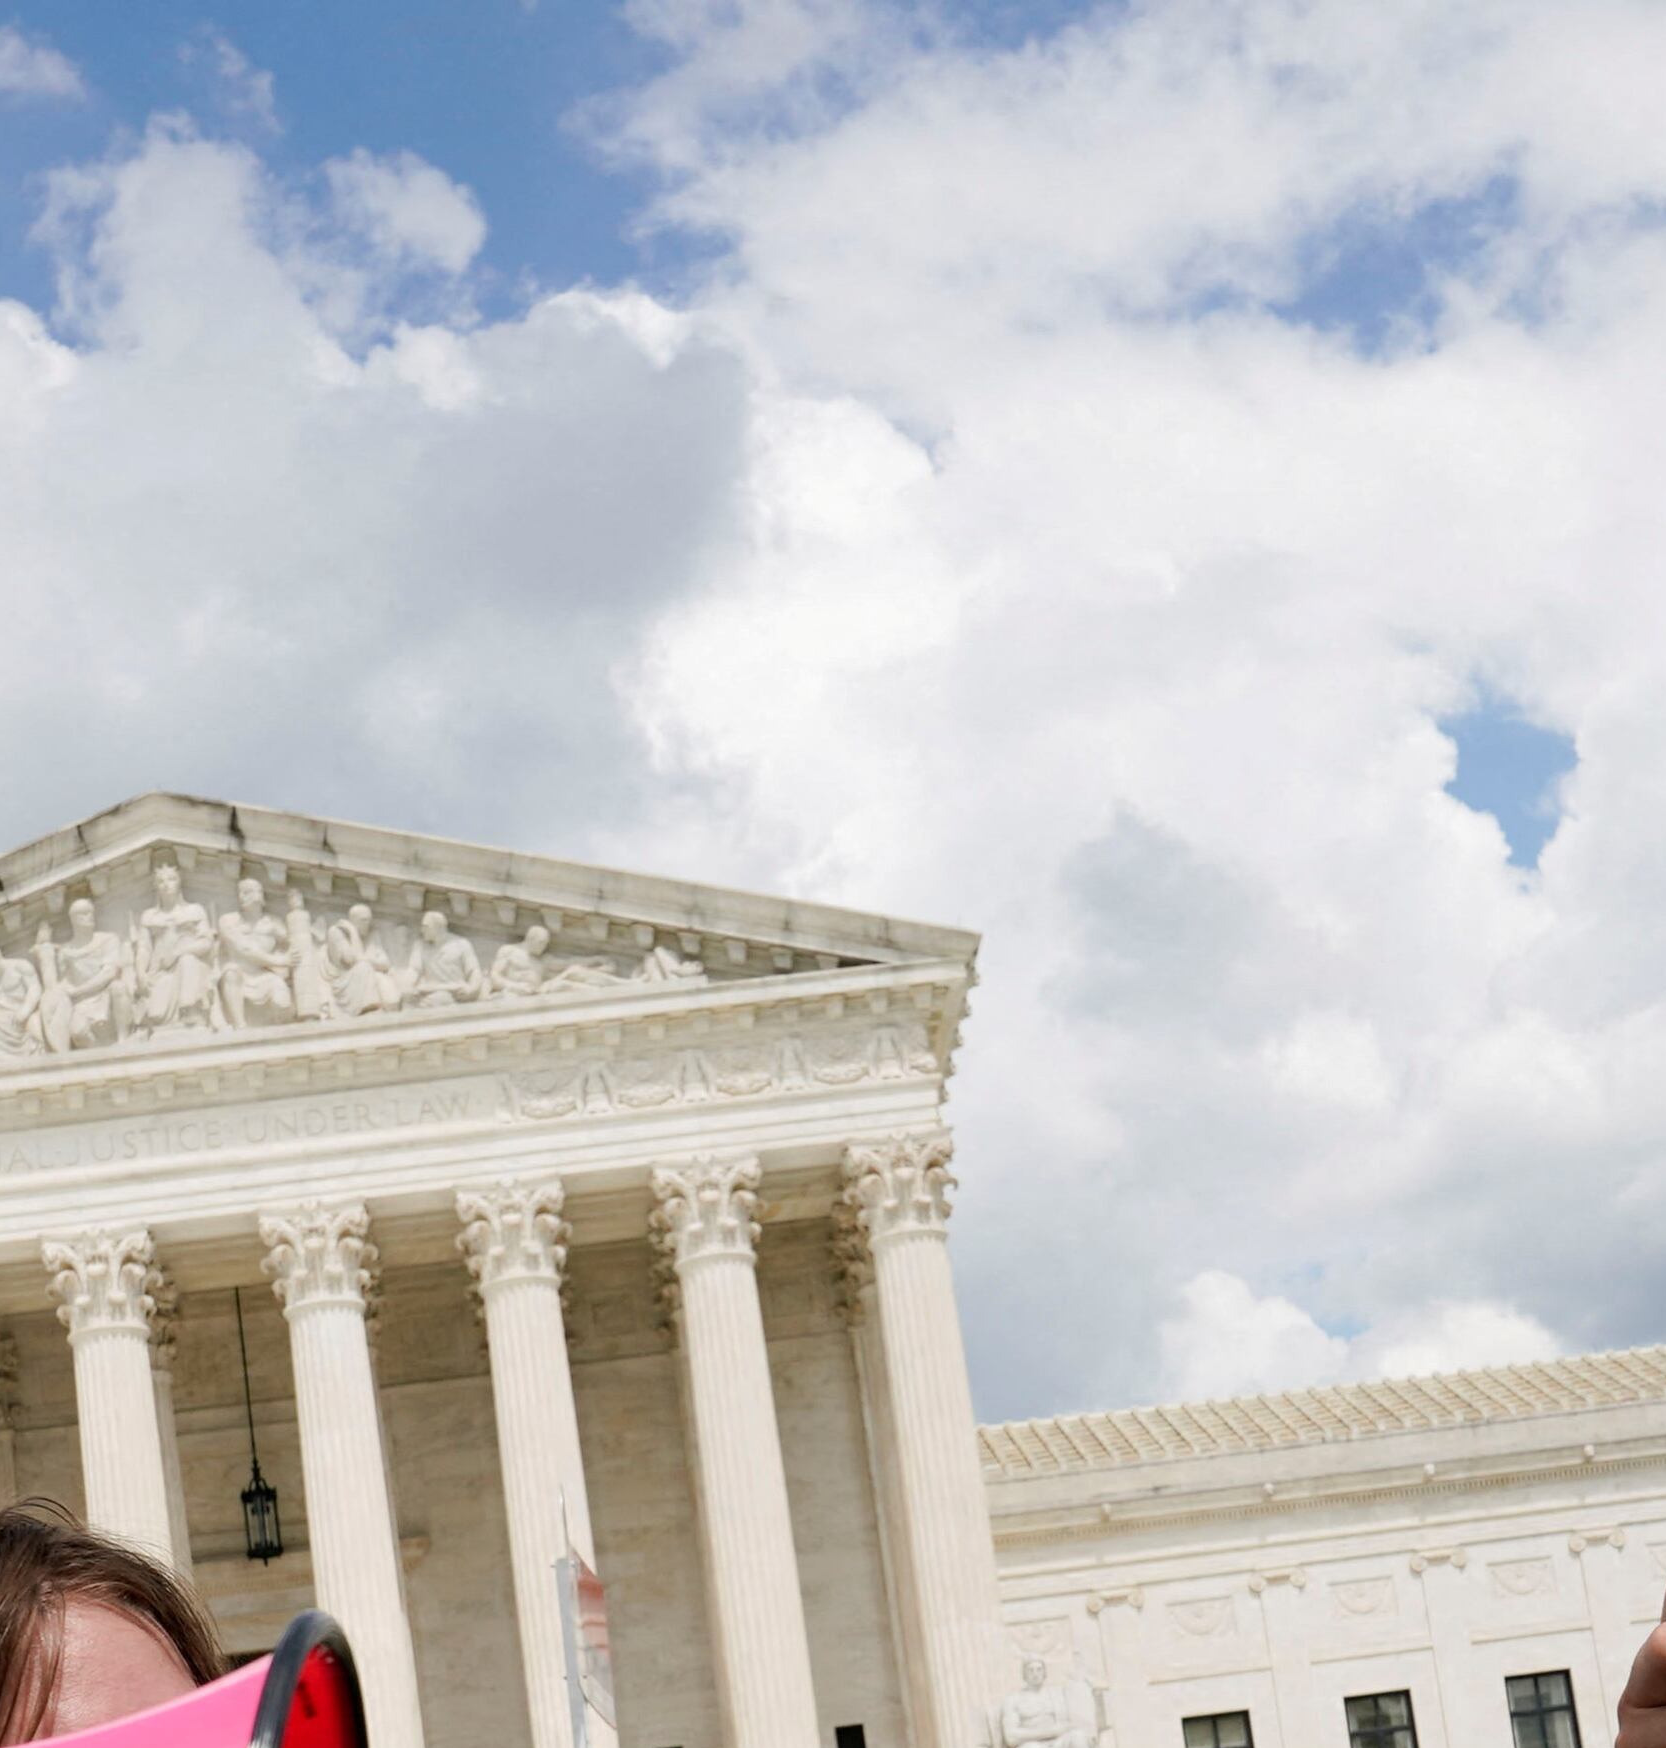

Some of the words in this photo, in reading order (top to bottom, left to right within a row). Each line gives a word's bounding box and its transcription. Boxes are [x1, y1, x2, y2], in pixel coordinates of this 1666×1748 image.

[63, 1120, 224, 1167] JUSTICE
[242, 1102, 382, 1143] UNDER
[391, 1089, 471, 1126] LAW
